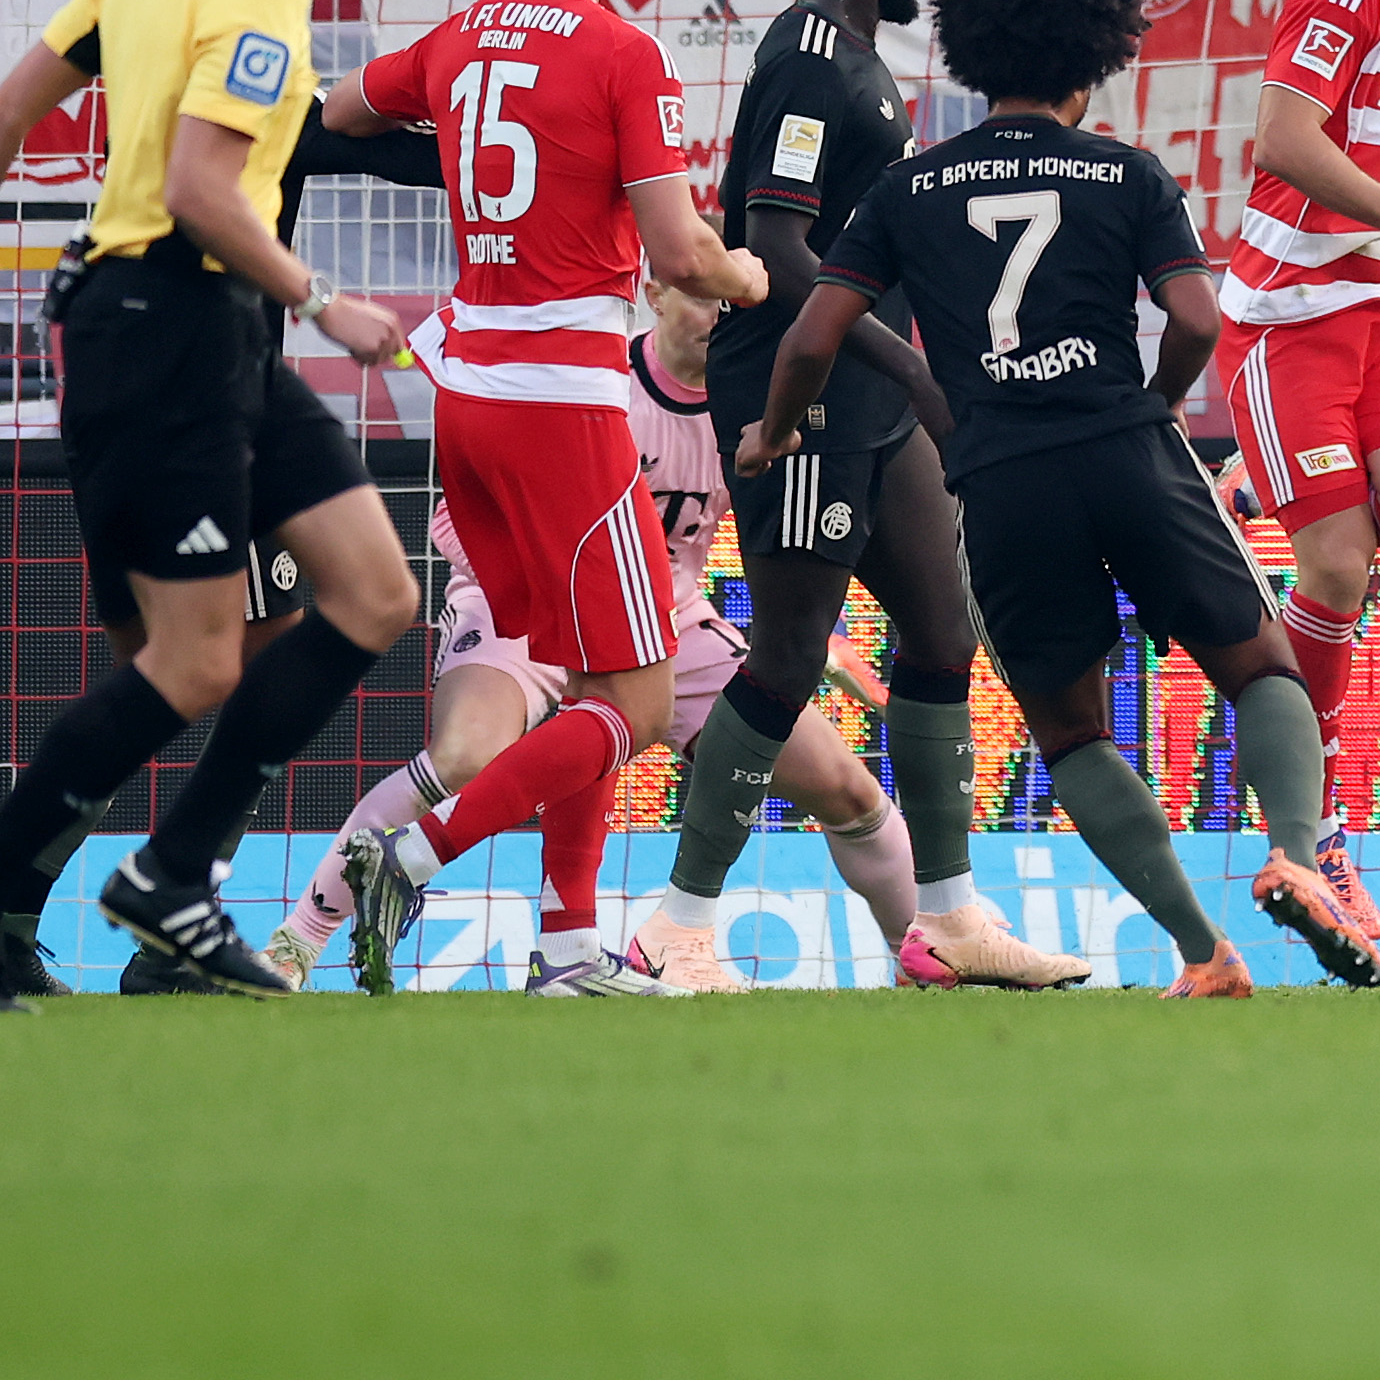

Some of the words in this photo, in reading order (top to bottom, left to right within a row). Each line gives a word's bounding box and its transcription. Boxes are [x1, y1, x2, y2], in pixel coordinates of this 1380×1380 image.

[473, 2, 500, 29] FC
[500, 1, 583, 39] UNION
[477, 30, 527, 51] BERLIN
[449, 60, 541, 223] 15
[994, 130, 1034, 140] FCBM
[911, 171, 935, 196] FC
[942, 158, 1020, 187] BAYERN
[1027, 156, 1125, 184] MÜNCHEN
[466, 233, 517, 265] ROTHE
[967, 189, 1062, 356] 7
[980, 335, 1099, 384] GNABRY
